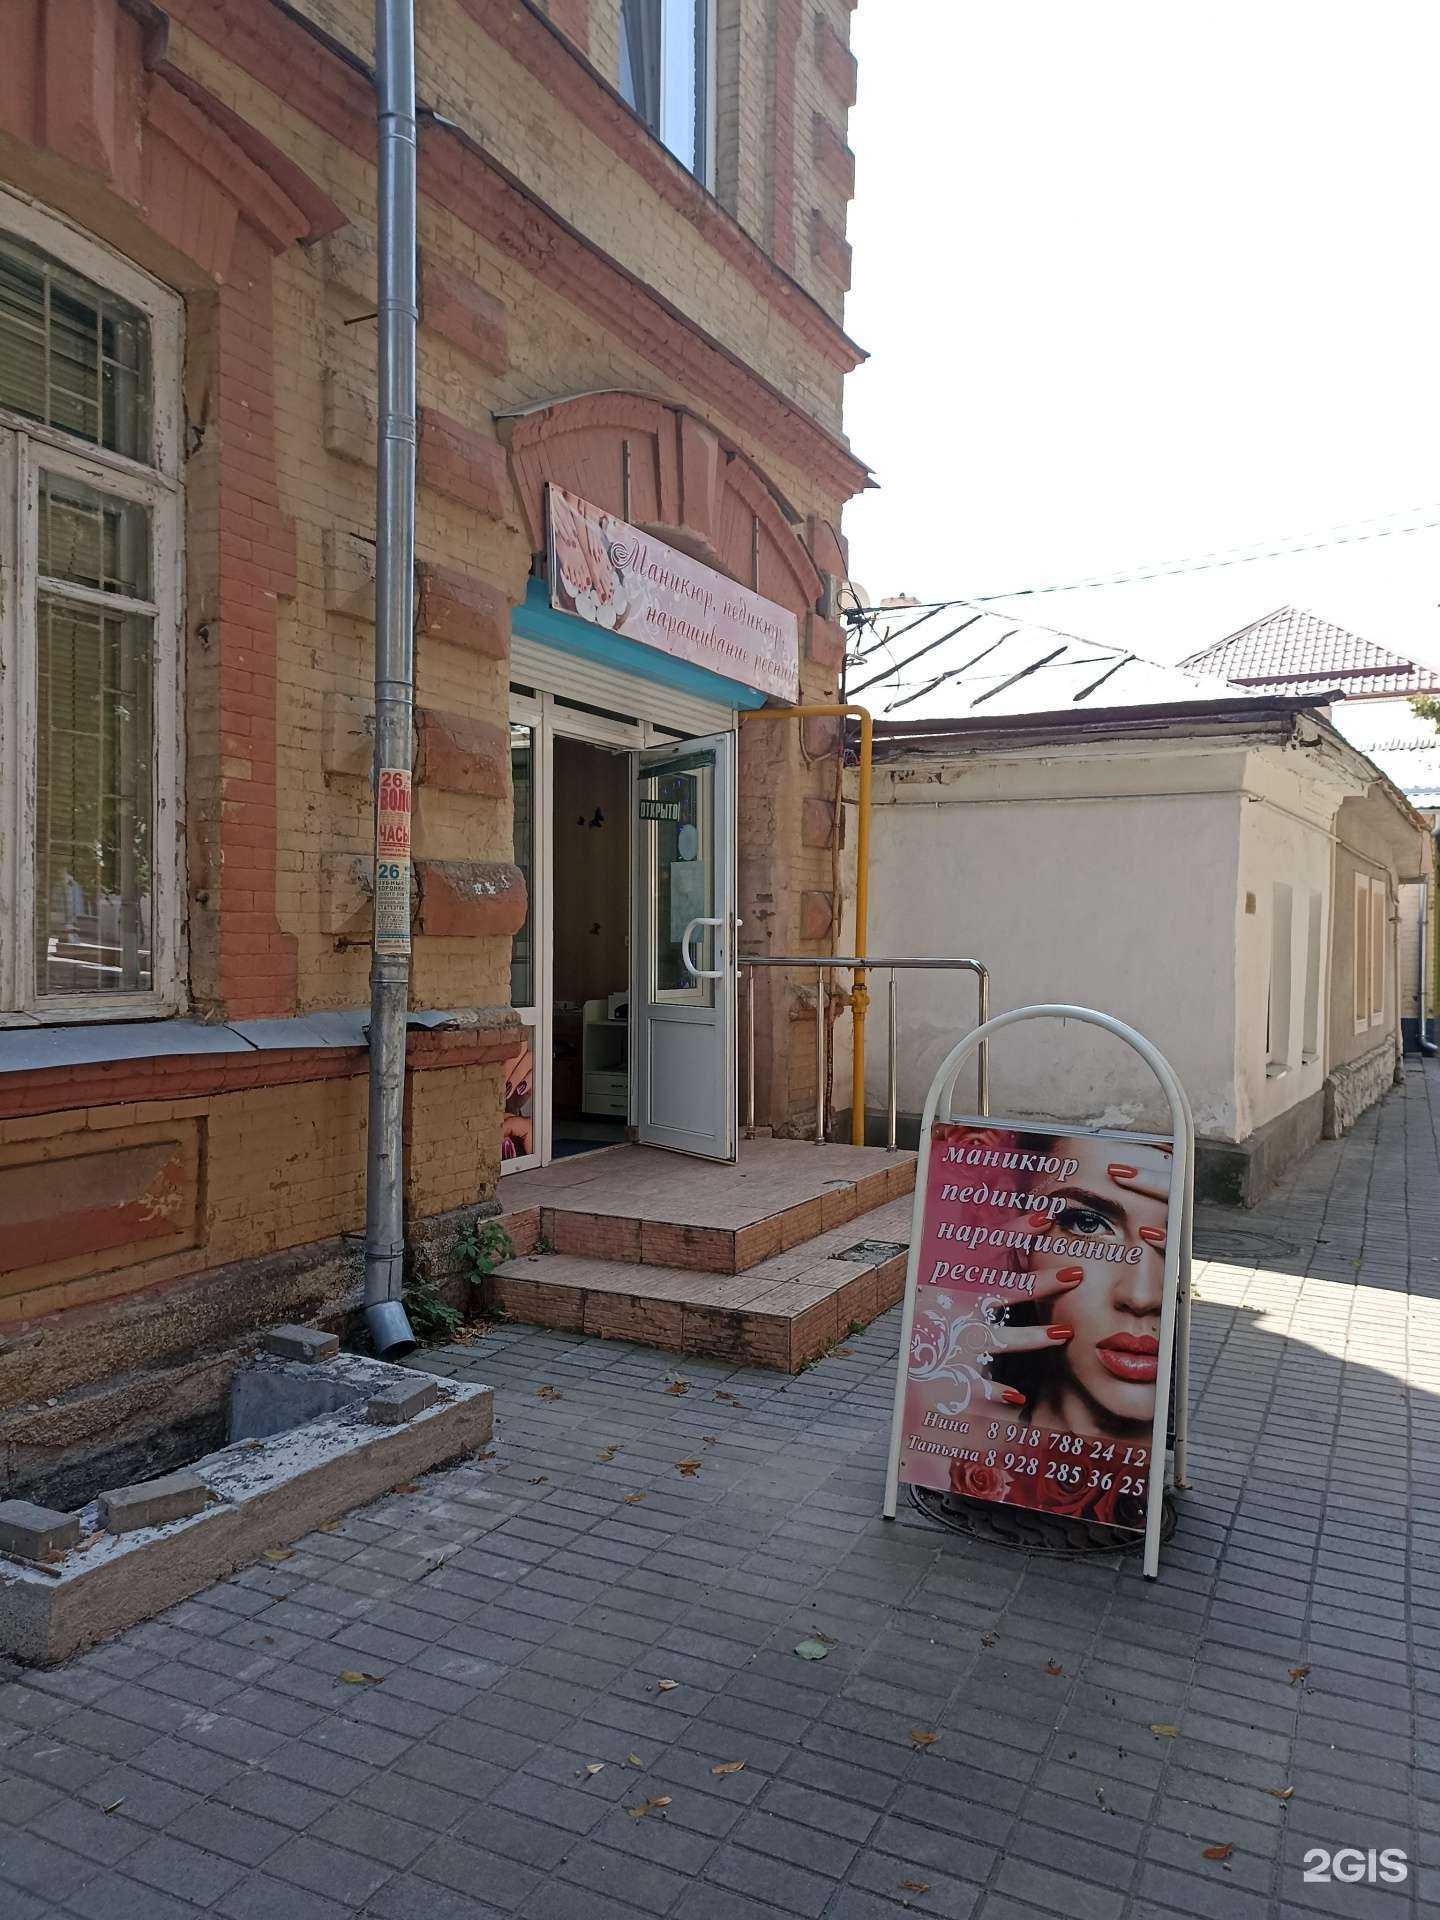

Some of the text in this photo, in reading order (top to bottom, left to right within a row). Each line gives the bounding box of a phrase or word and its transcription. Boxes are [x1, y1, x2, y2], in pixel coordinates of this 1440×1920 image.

[647, 606, 748, 665] наращивание
[382, 772, 402, 787] 26
[640, 801, 679, 820] ОТКРЫТО
[378, 864, 399, 879] 26
[942, 1145, 1079, 1182] маникюр
[941, 1182, 1067, 1220] педикюр
[937, 1222, 1143, 1265] наращивание
[930, 1259, 1037, 1296] ресниц
[923, 1411, 1147, 1467] Нина 8 918 788 24 12
[907, 1434, 1146, 1497] Татьяна 8 928 285 36 25
